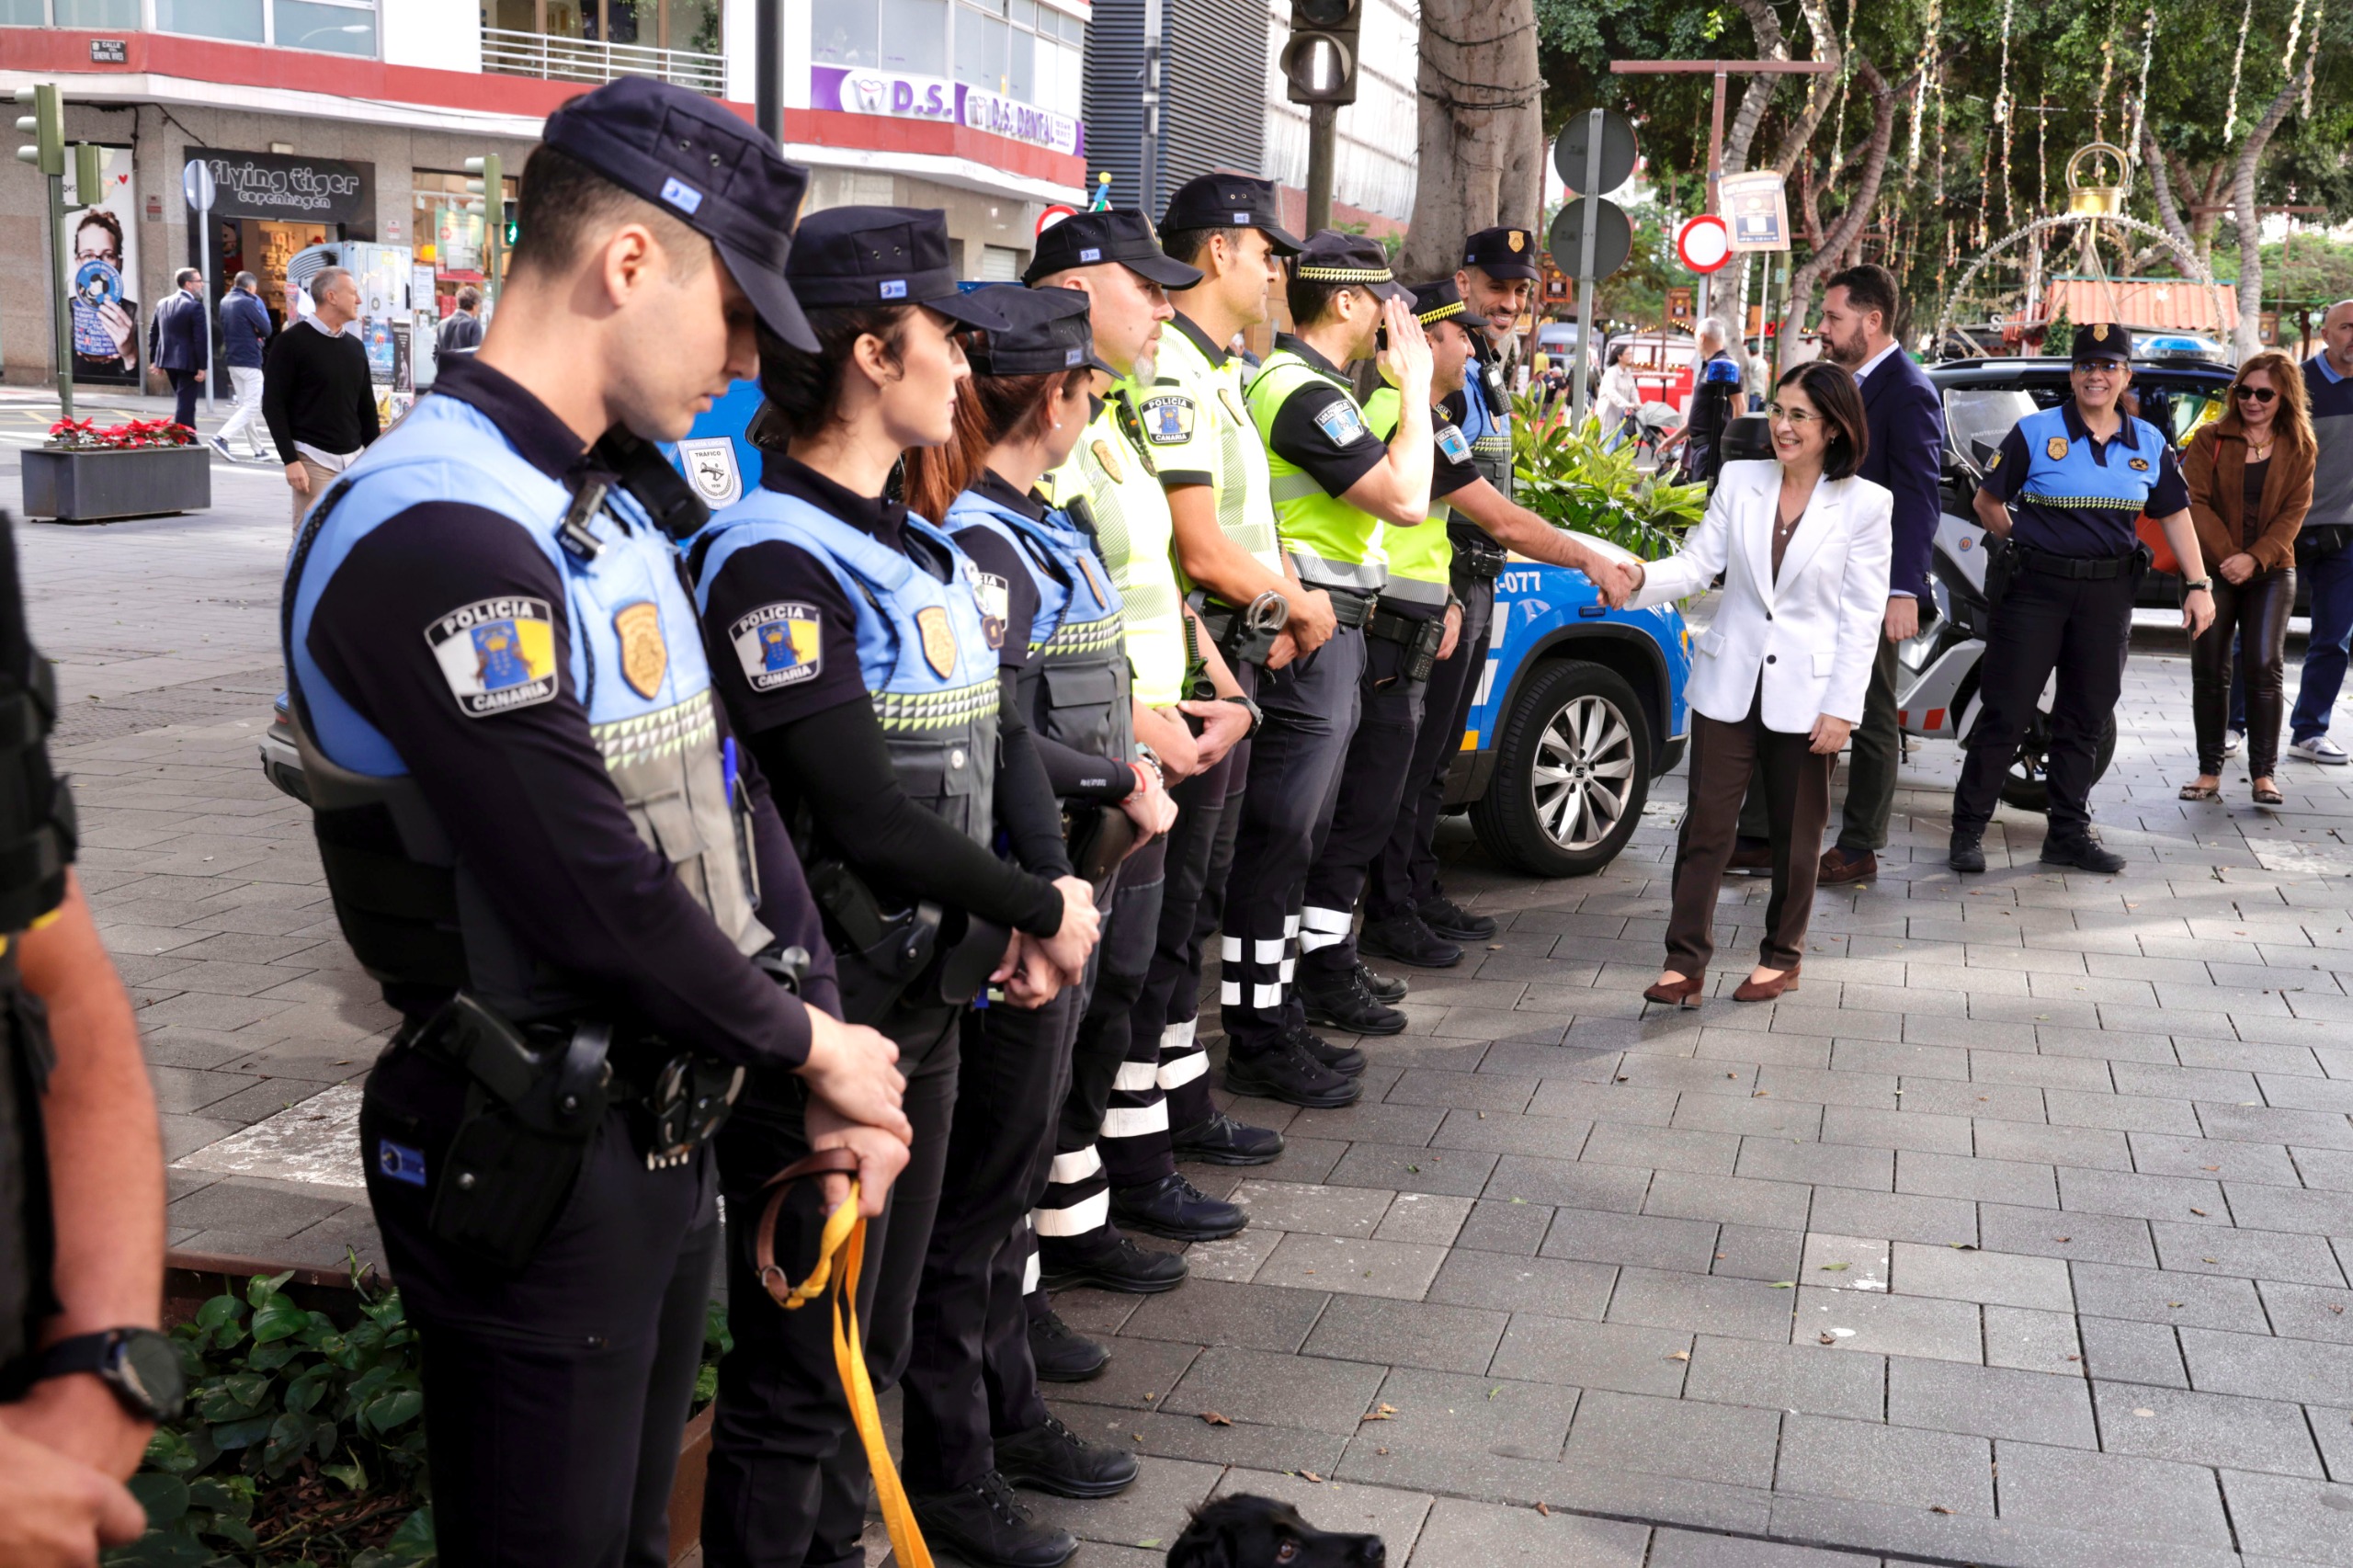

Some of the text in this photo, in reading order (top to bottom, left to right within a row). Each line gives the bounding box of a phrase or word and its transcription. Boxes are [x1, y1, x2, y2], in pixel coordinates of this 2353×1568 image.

[892, 80, 953, 116] D.S.
[209, 160, 359, 198] flying tiger
[238, 190, 331, 210] copenhagen
[1149, 398, 1188, 409] POLICIA
[442, 600, 534, 636] POLICIA
[740, 607, 804, 633] POLICIA
[757, 665, 813, 687] CANARIA
[472, 681, 549, 710] CANARIA
